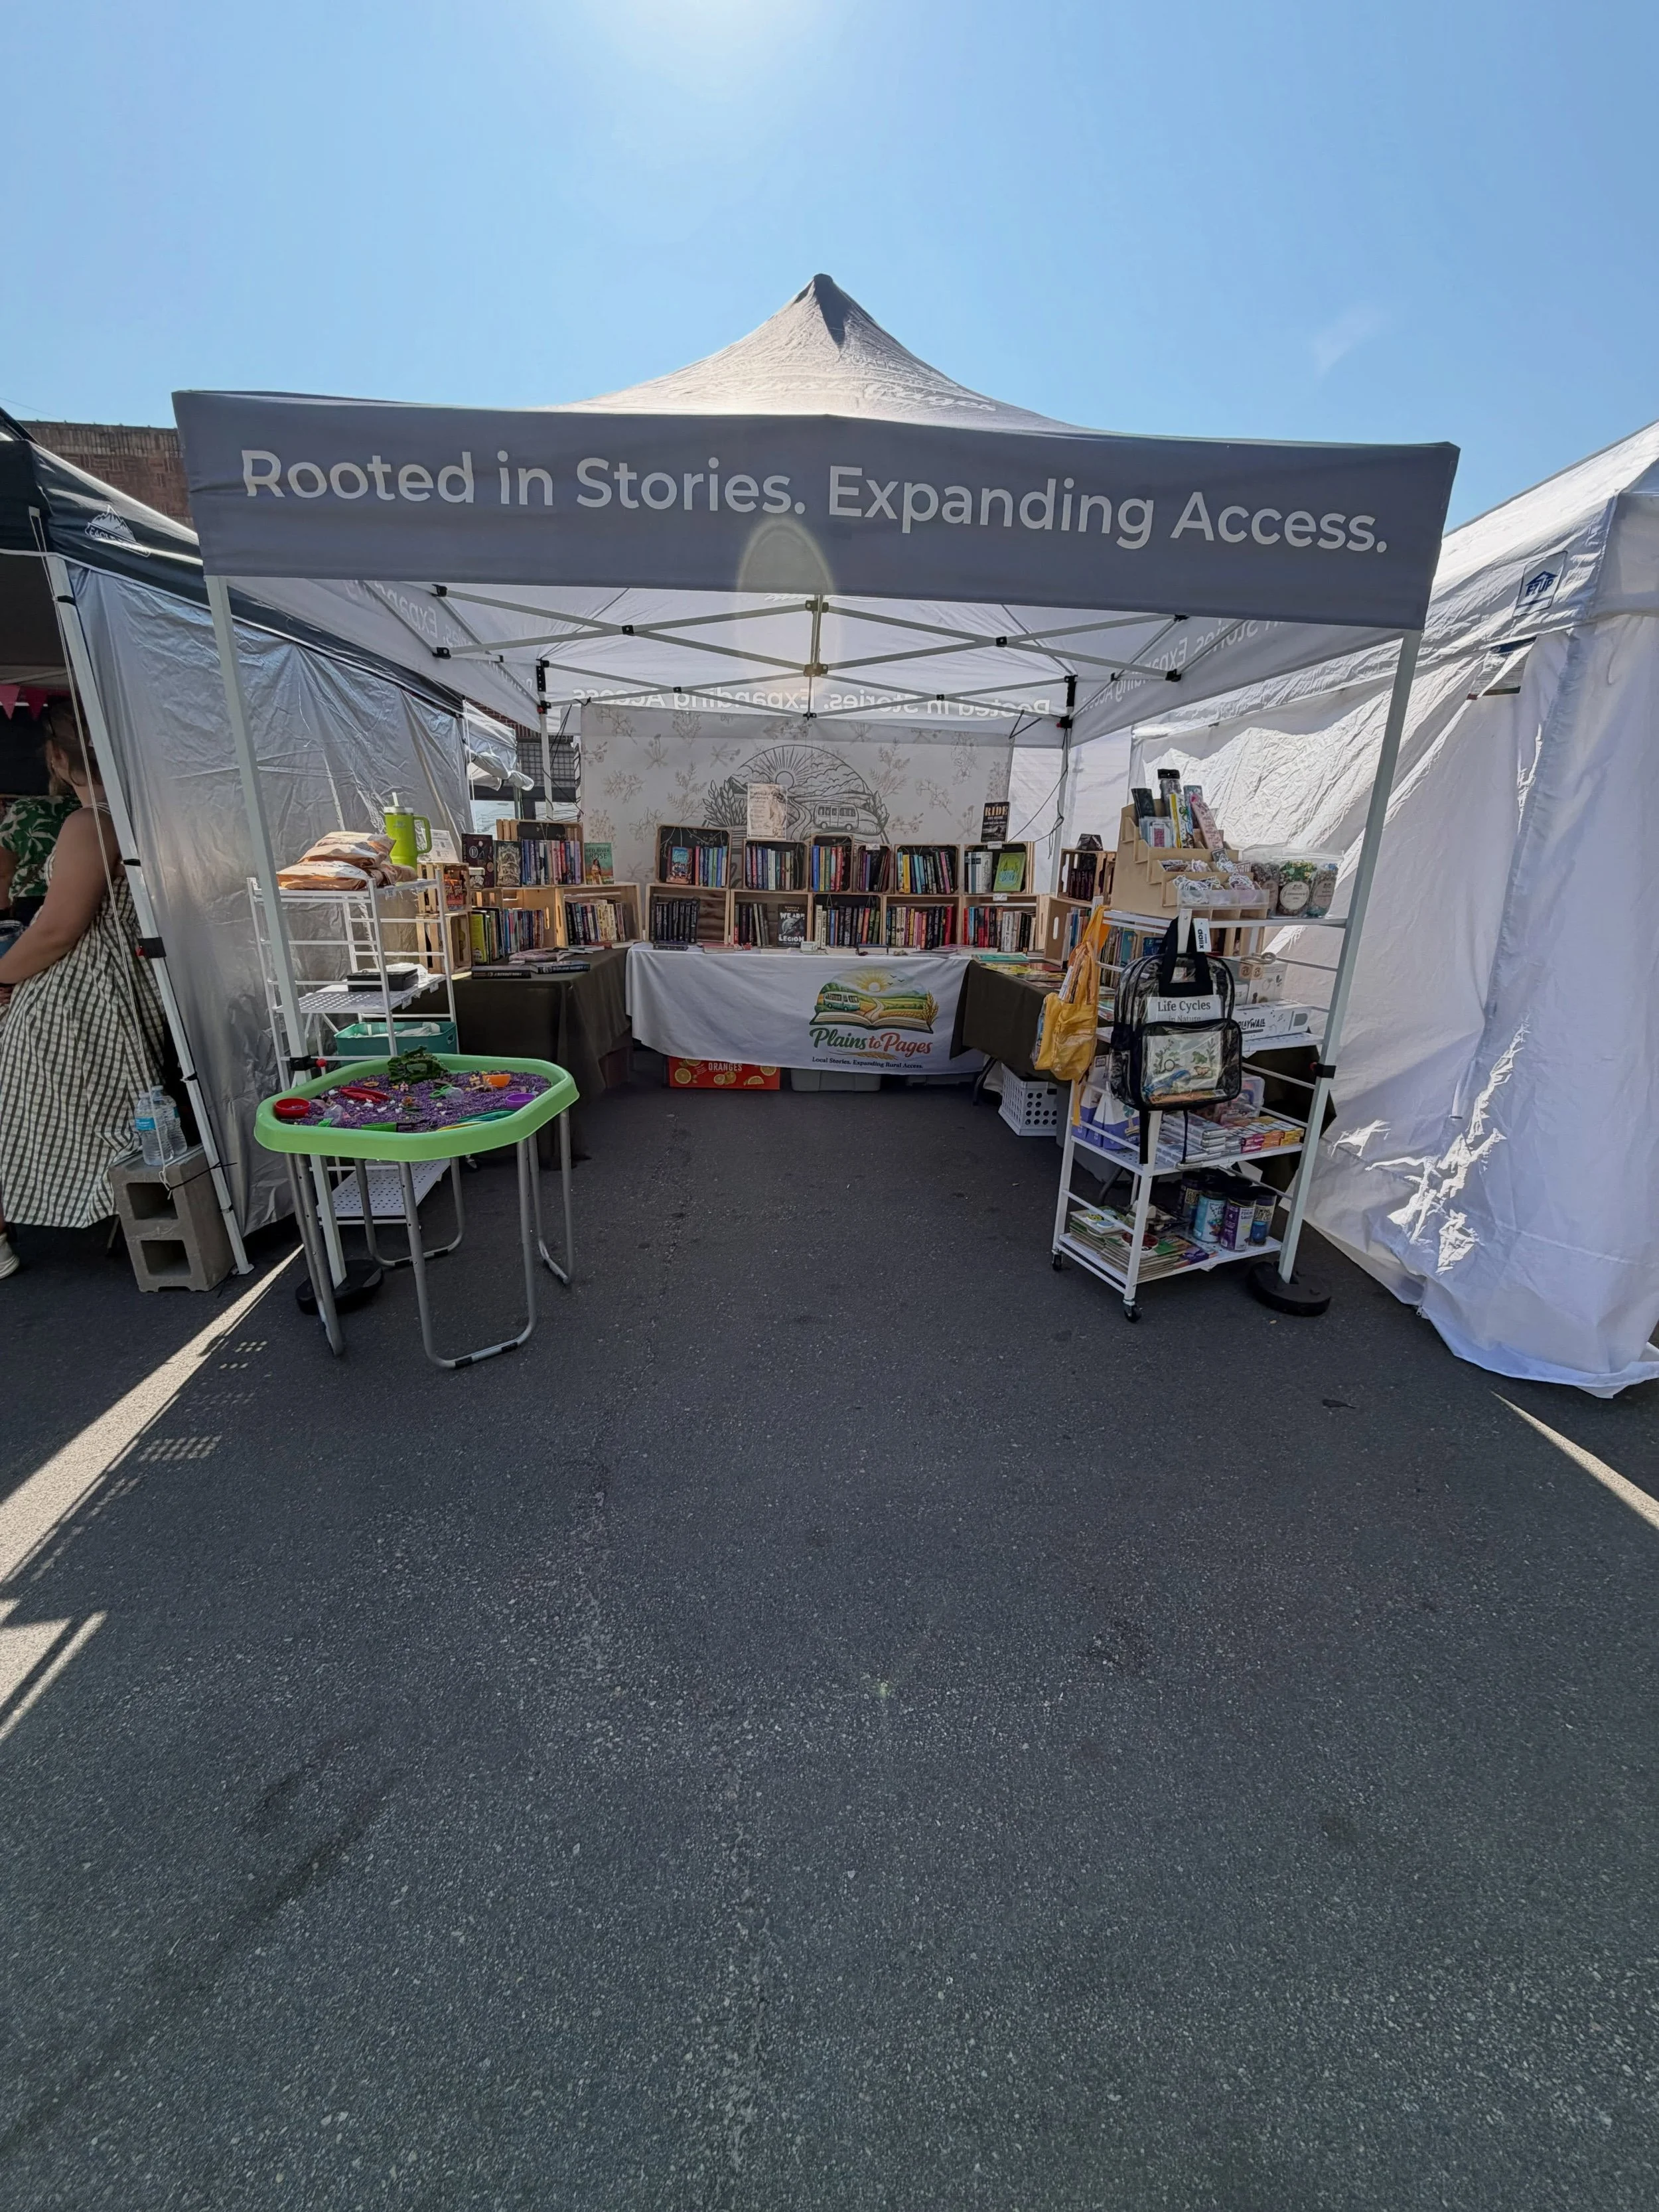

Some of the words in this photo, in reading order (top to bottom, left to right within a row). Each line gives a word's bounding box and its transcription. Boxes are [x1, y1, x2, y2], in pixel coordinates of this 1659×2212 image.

[242, 449, 474, 504] Rooted
[497, 449, 553, 506] in
[577, 457, 806, 514] Stories.
[829, 465, 1155, 550] Expanding
[1170, 491, 1388, 553] Access.
[985, 806, 1008, 816] RIDE
[778, 934, 804, 942] LEGION
[1157, 1001, 1177, 1011] Life
[1179, 1000, 1211, 1013] Cycles
[809, 1027, 868, 1050] Plains
[868, 1035, 883, 1049] to
[881, 1032, 934, 1058] Pages
[708, 1062, 743, 1071] ORANGES
[853, 1059, 884, 1068] Expanding
